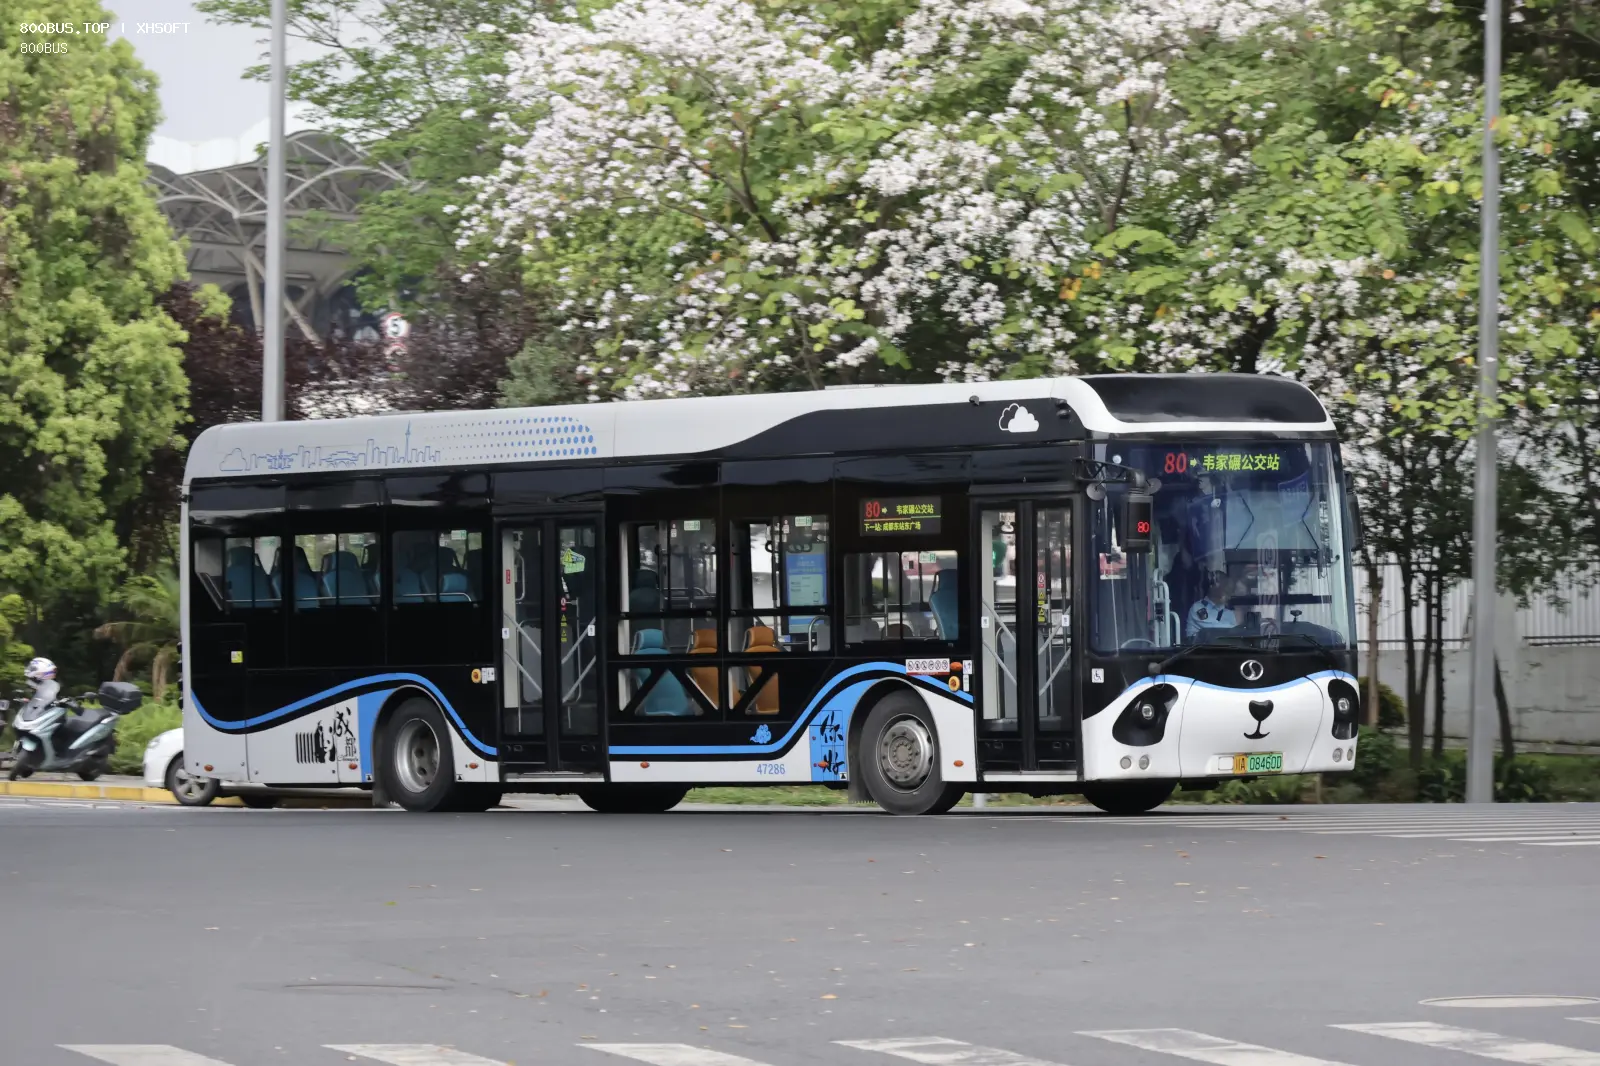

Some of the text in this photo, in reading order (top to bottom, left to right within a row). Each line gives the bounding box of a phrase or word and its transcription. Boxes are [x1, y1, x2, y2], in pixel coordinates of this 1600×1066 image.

[1164, 452, 1280, 474] 80 韦家碾公交站
[865, 501, 881, 518] 80
[1137, 521, 1150, 533] 80
[756, 763, 786, 775] 47286
